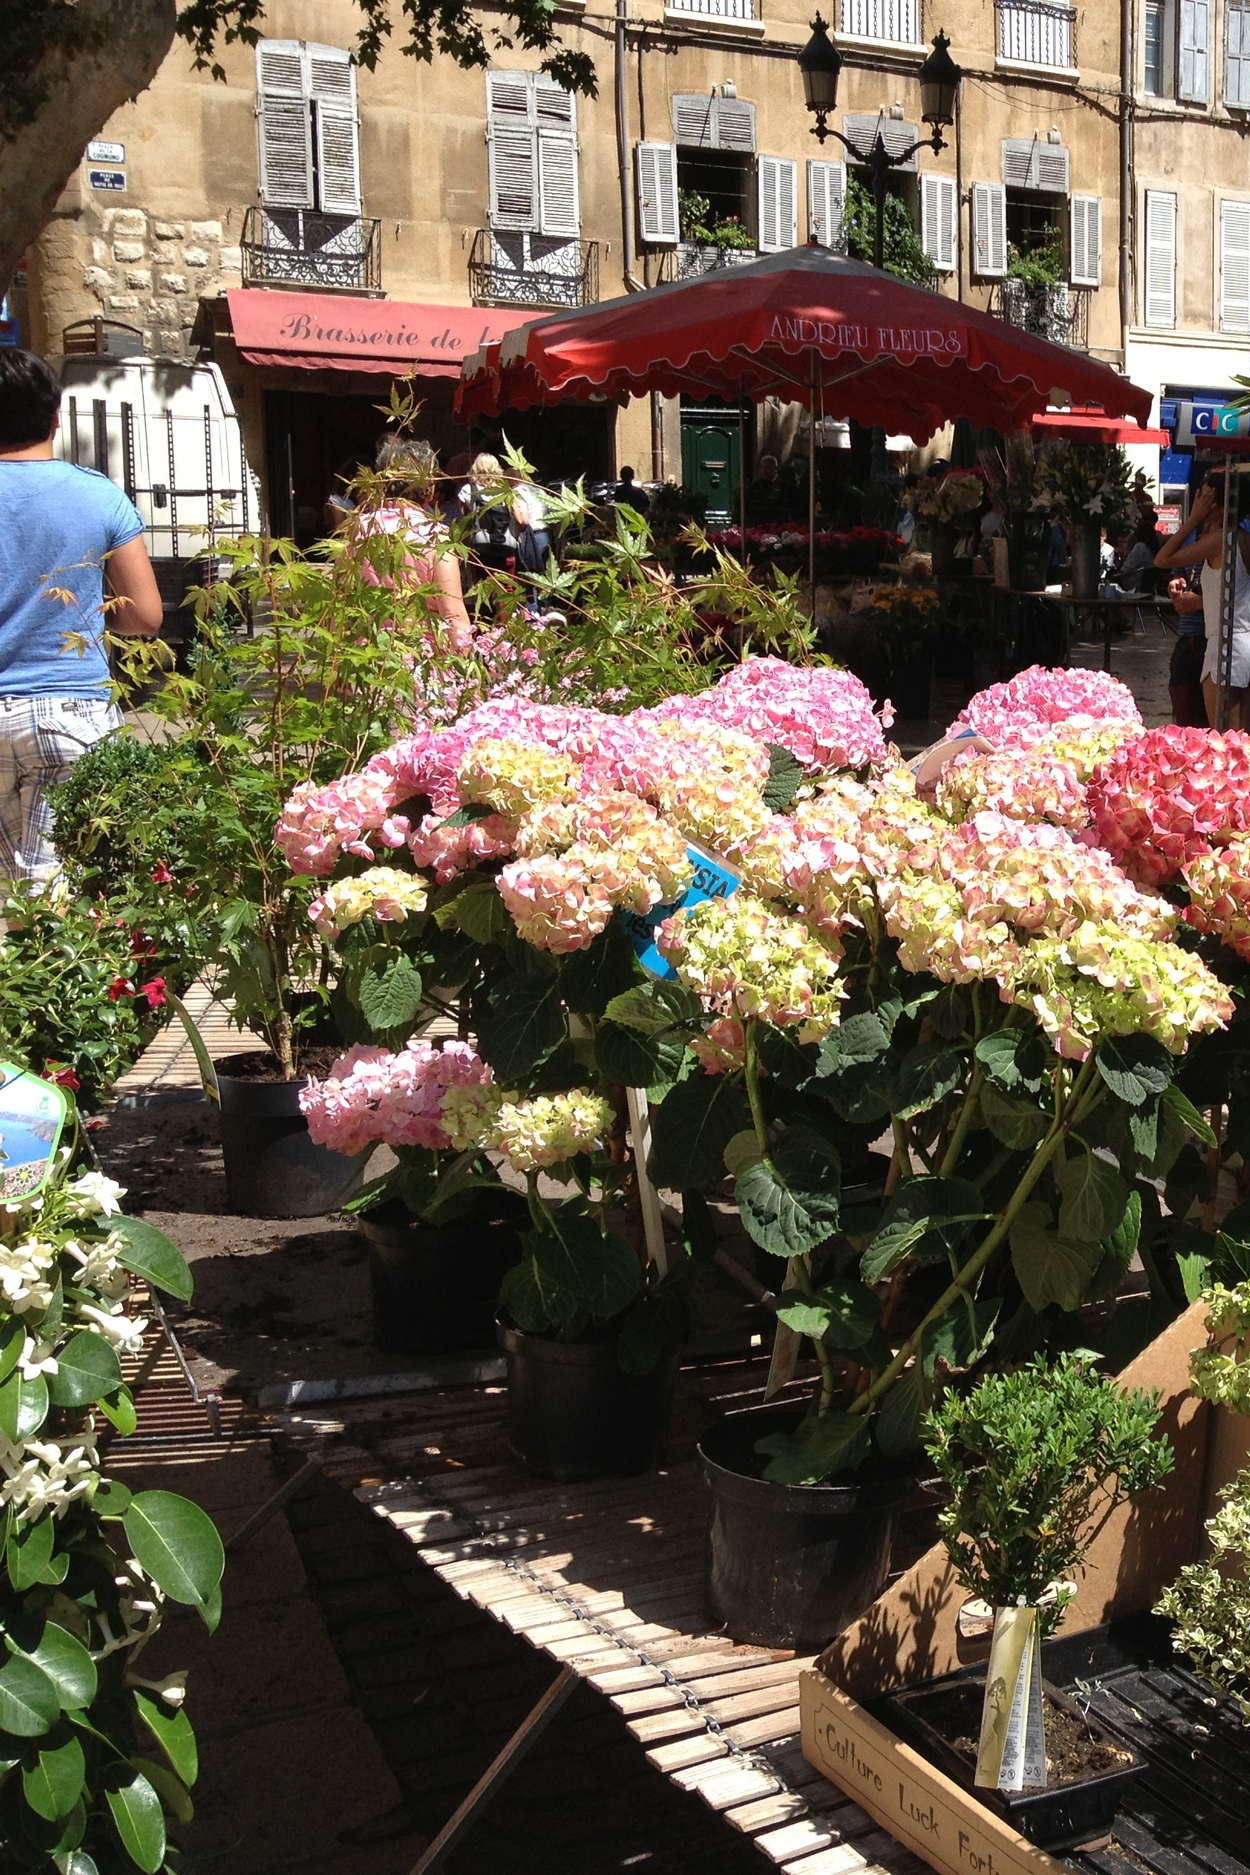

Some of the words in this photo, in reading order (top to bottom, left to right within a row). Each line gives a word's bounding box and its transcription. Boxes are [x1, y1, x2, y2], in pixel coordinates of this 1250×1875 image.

[280, 312, 420, 346] Brasserie
[431, 328, 462, 350] de
[770, 315, 868, 348] ANDRIEU
[878, 327, 962, 354] FLEURS
[1195, 412, 1235, 432] CIC
[825, 1723, 883, 1792] Culture
[899, 1782, 941, 1839] Luck
[957, 1830, 1001, 1875] Fort
